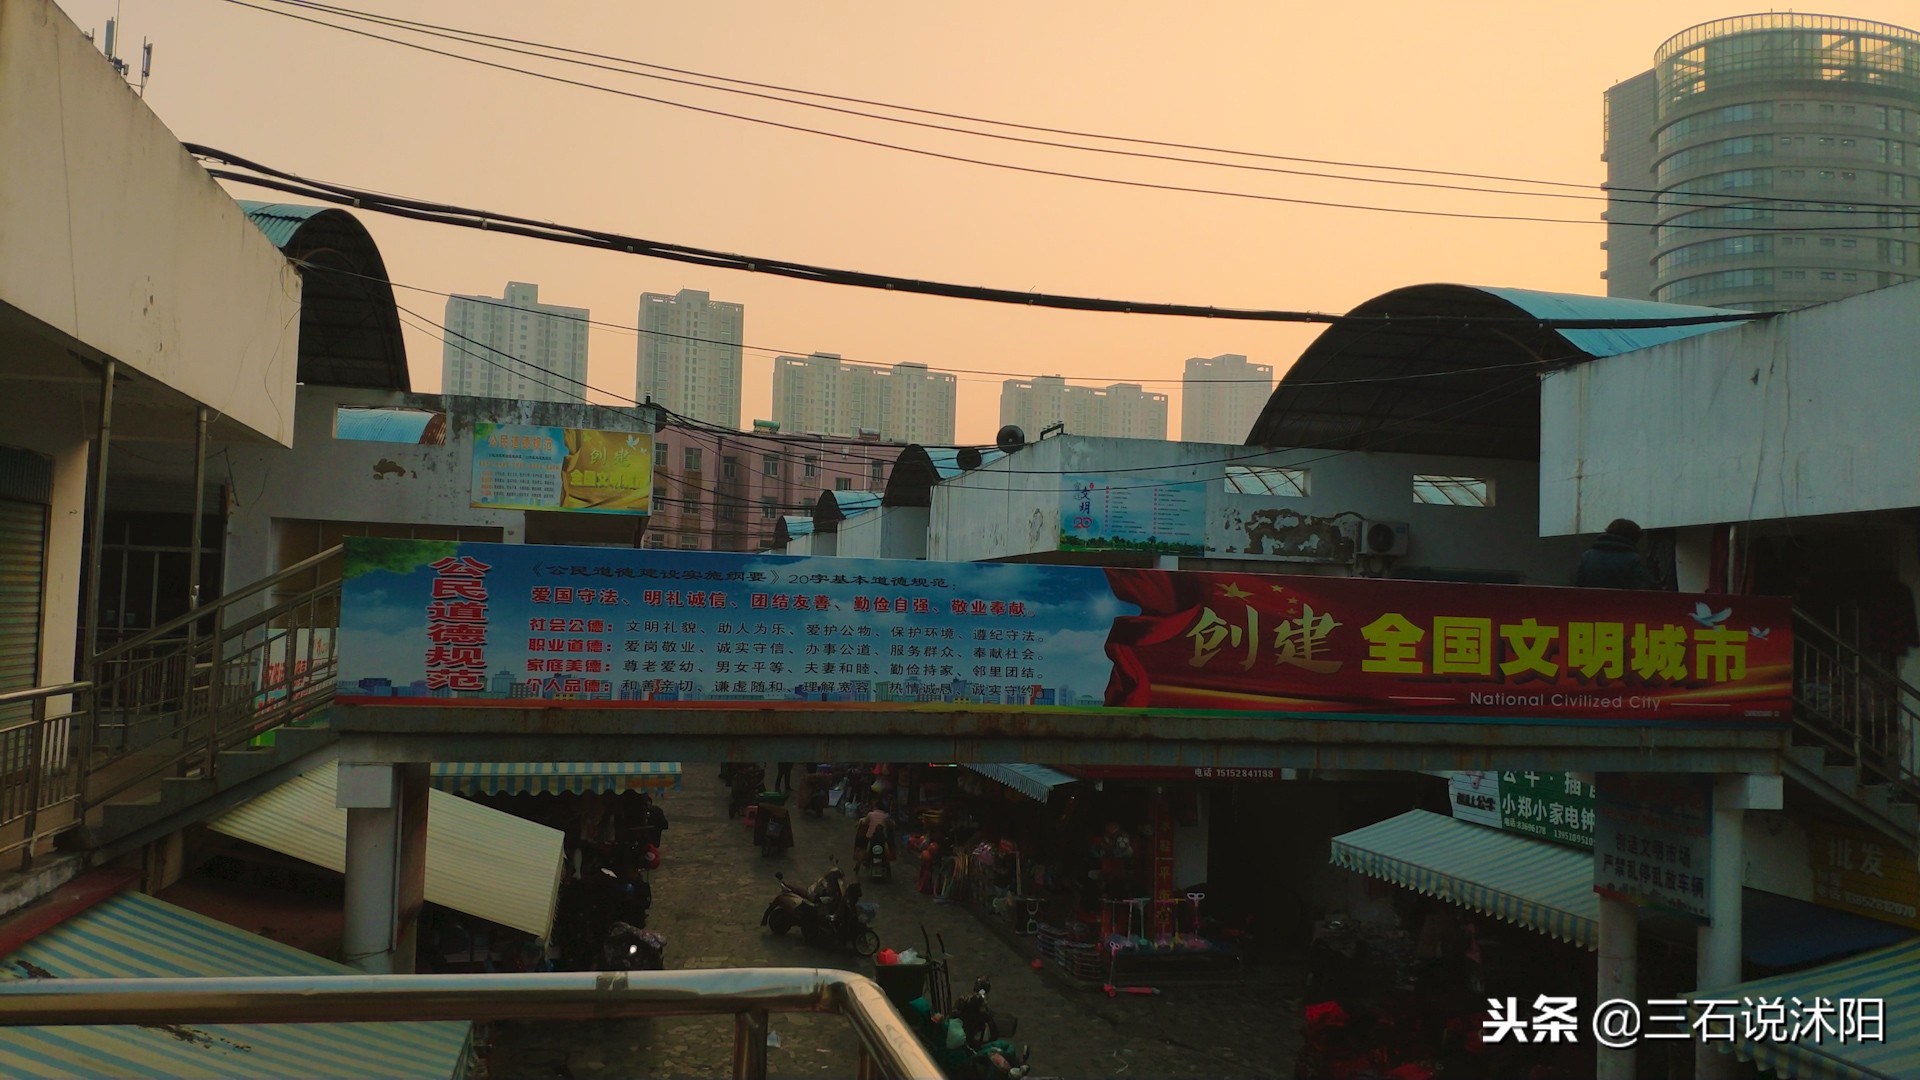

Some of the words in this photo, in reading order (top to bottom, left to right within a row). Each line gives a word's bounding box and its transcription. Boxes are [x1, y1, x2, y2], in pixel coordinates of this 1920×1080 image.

[427, 556, 492, 690] 公民道德规范
[1185, 603, 1344, 674] 创建
[1360, 612, 1748, 682] 全国文明城市
[1470, 692, 1544, 707] National
[1550, 693, 1623, 709] Civilized
[1628, 695, 1661, 712] City
[1194, 768, 1212, 777] 电话
[1554, 829, 1595, 847] 1395109510
